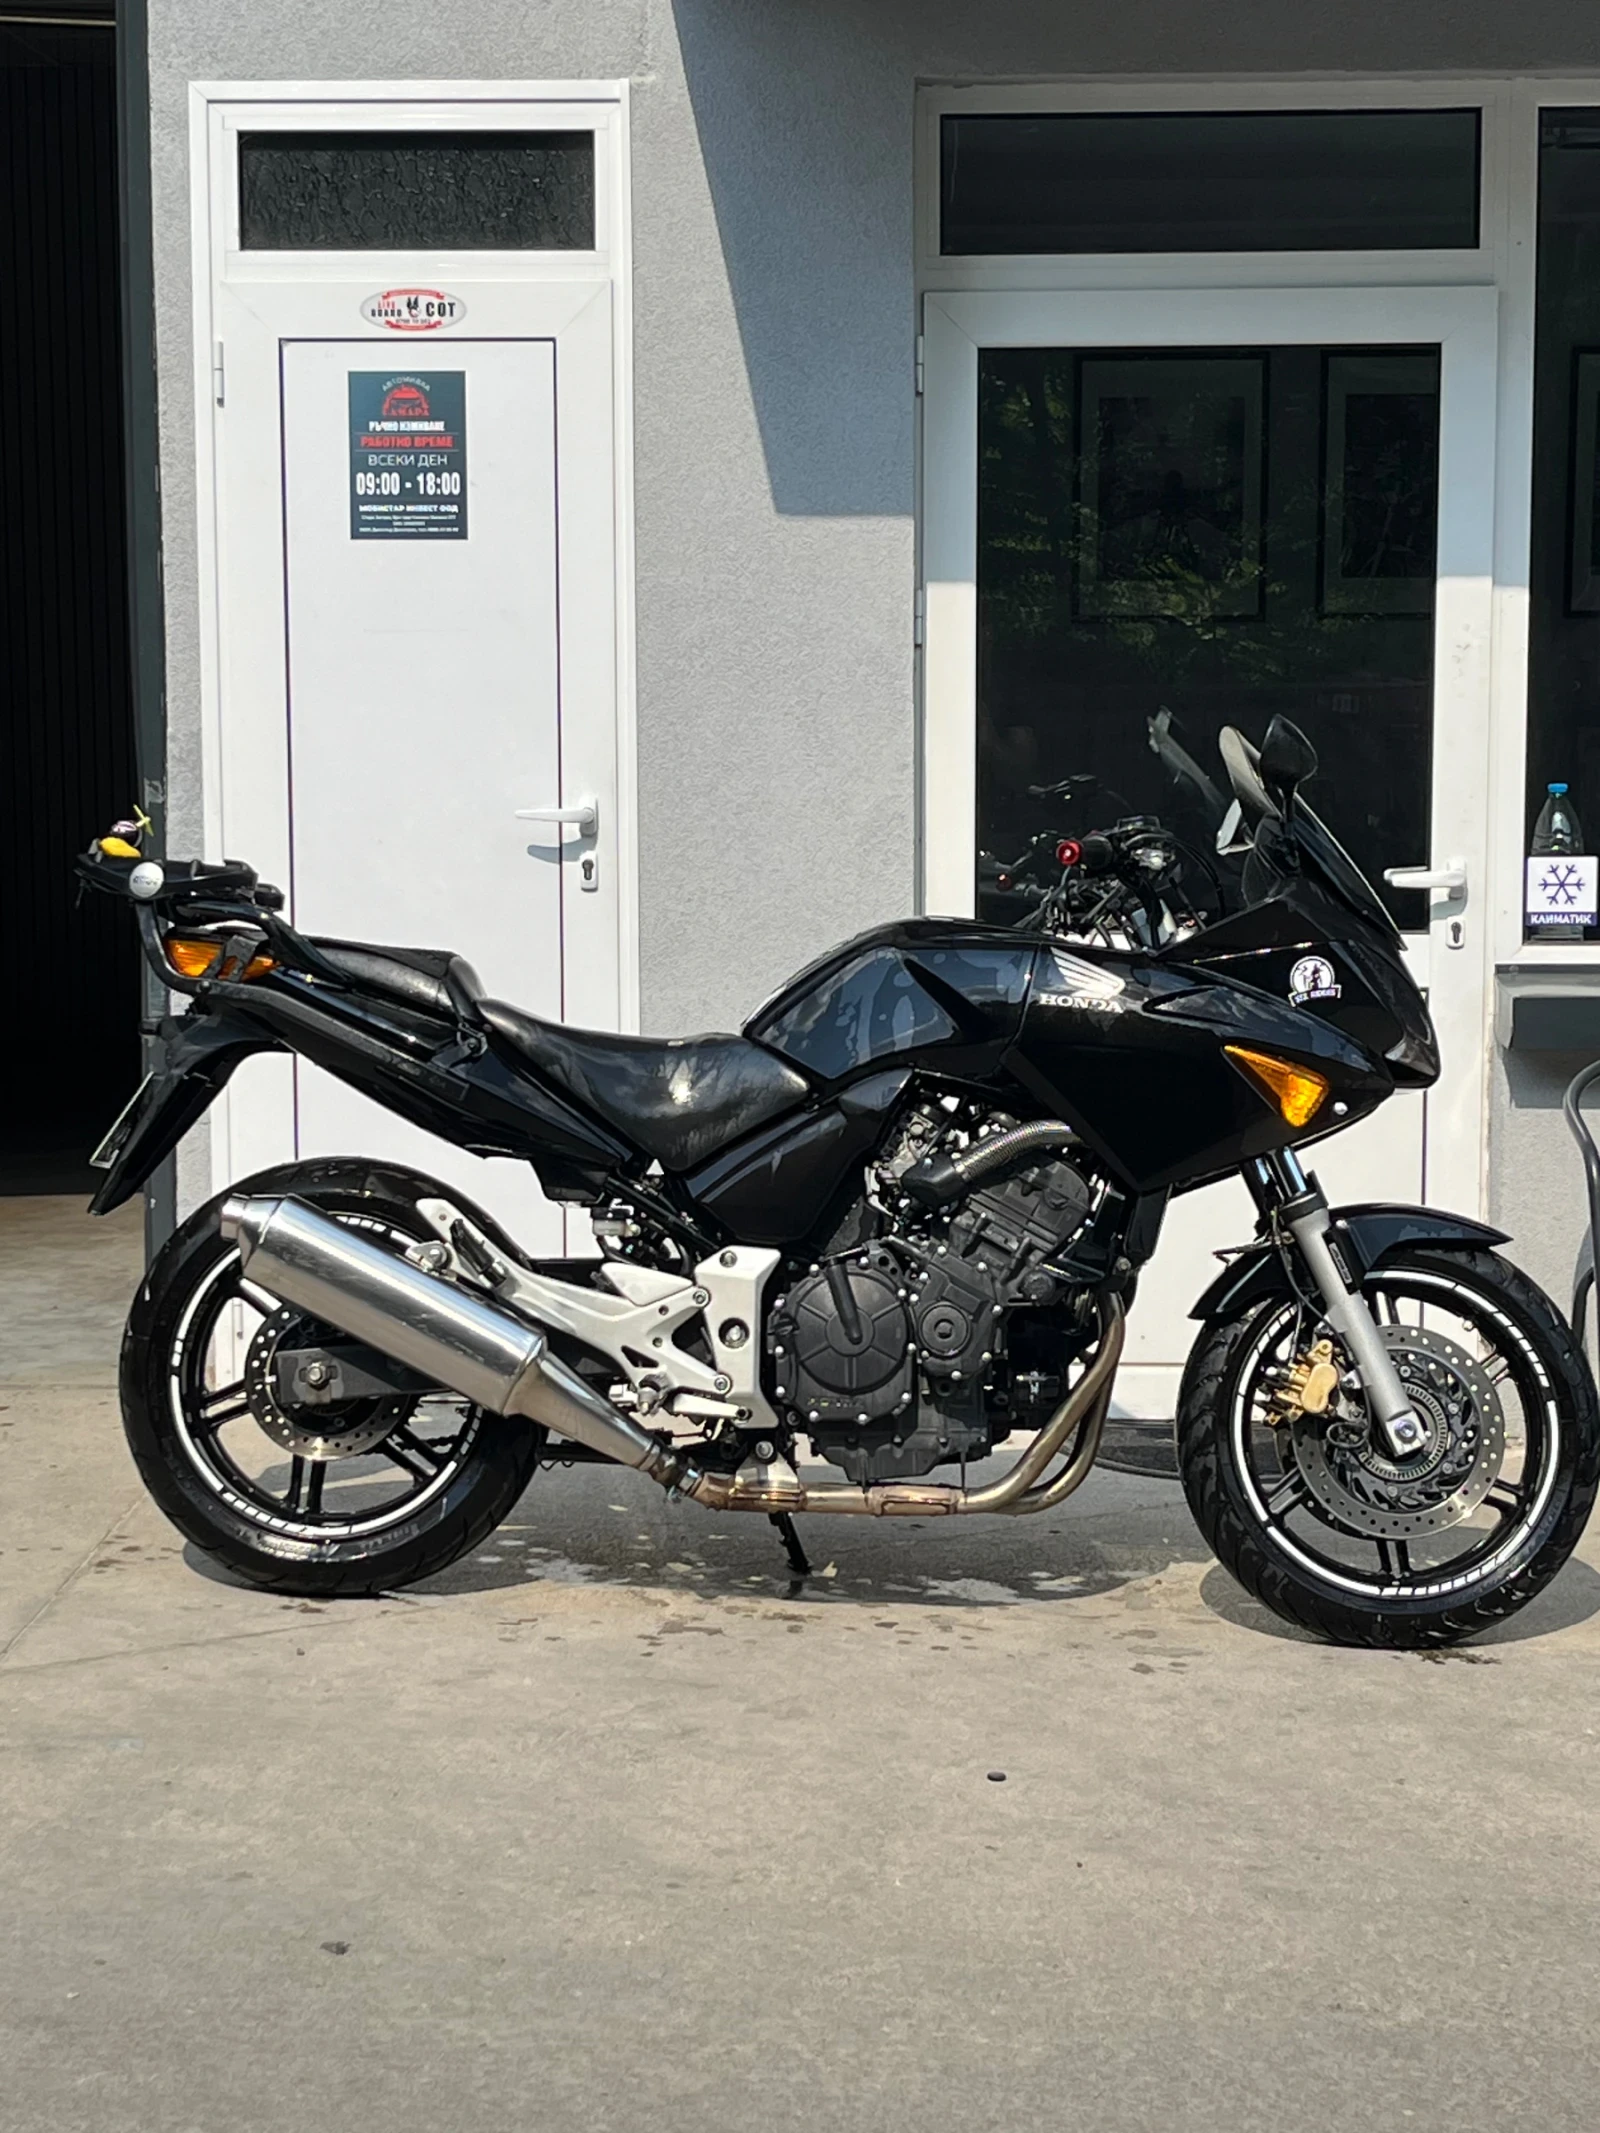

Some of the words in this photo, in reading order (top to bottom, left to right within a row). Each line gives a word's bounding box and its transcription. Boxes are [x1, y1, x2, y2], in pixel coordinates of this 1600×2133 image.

[361, 436, 412, 447] РАБОТНО
[414, 436, 453, 447] ВРЕМЕ
[368, 454, 415, 466] ВСЕКИ
[417, 454, 448, 468] ДЕН
[356, 472, 400, 495] 09:00
[416, 472, 461, 495] 18:00
[1530, 914, 1592, 925] КЛИМАТИК
[1039, 993, 1125, 1014] HONDA
